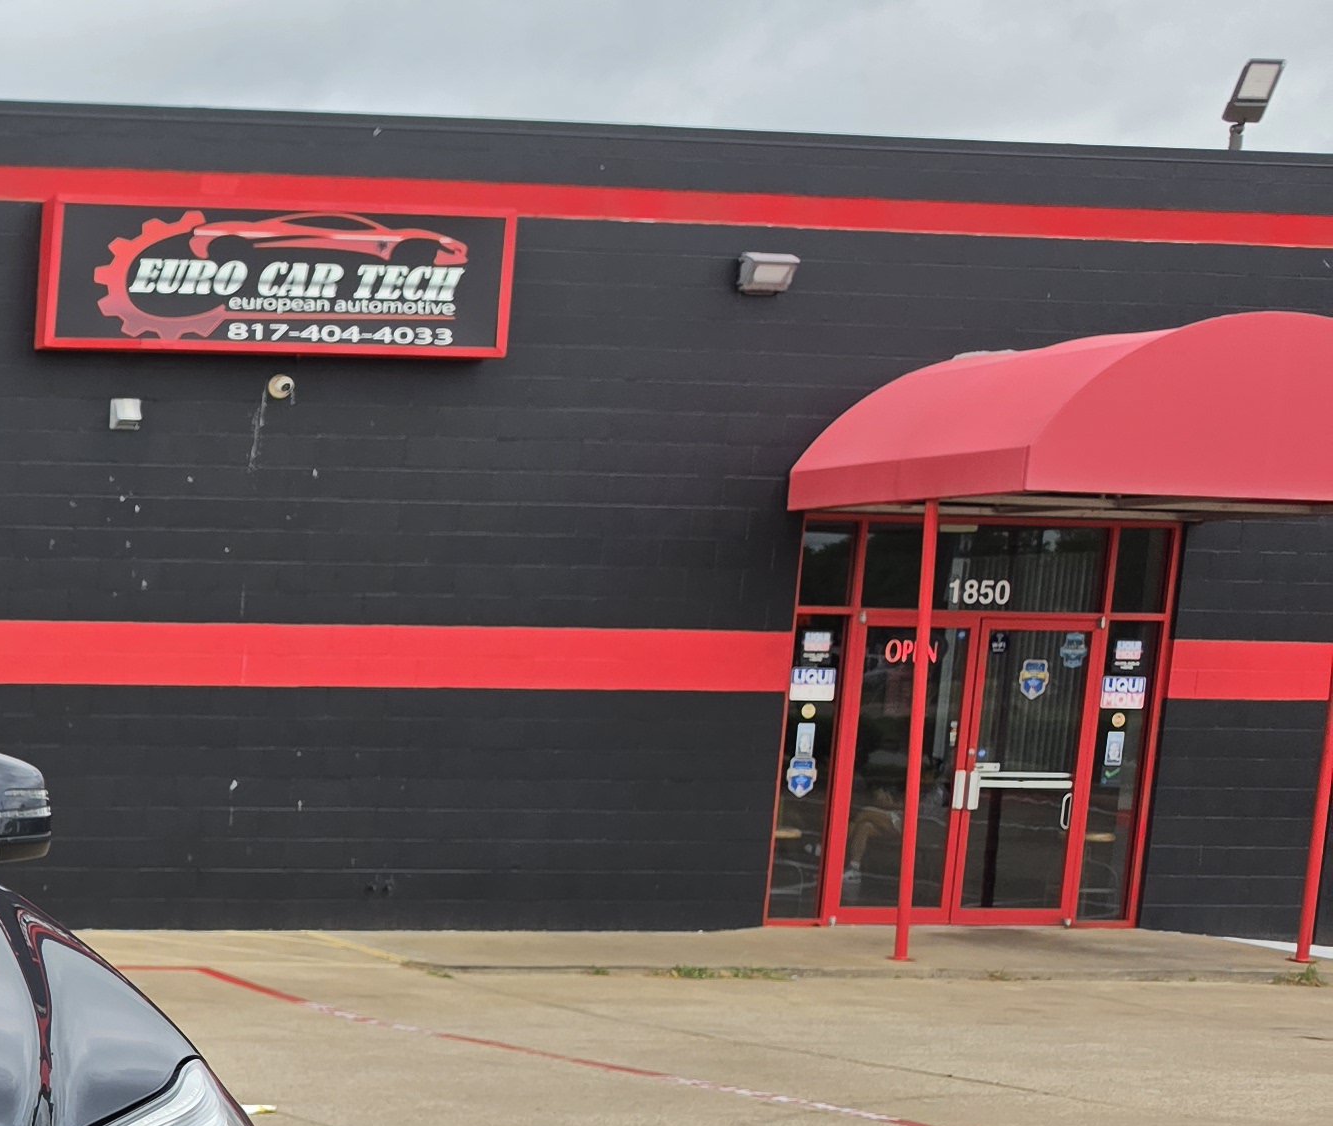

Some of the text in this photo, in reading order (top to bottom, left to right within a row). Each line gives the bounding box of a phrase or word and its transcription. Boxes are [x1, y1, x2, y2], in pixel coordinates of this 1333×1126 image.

[129, 258, 466, 302] EURO CAR TECH
[228, 296, 456, 317] european automotive
[227, 322, 454, 346] 817-404-4033
[949, 579, 1011, 605] 1850
[885, 638, 939, 663] OPN
[793, 669, 834, 686] LIQUI
[1105, 678, 1144, 693] LIQUI
[1103, 693, 1144, 707] MOLY
